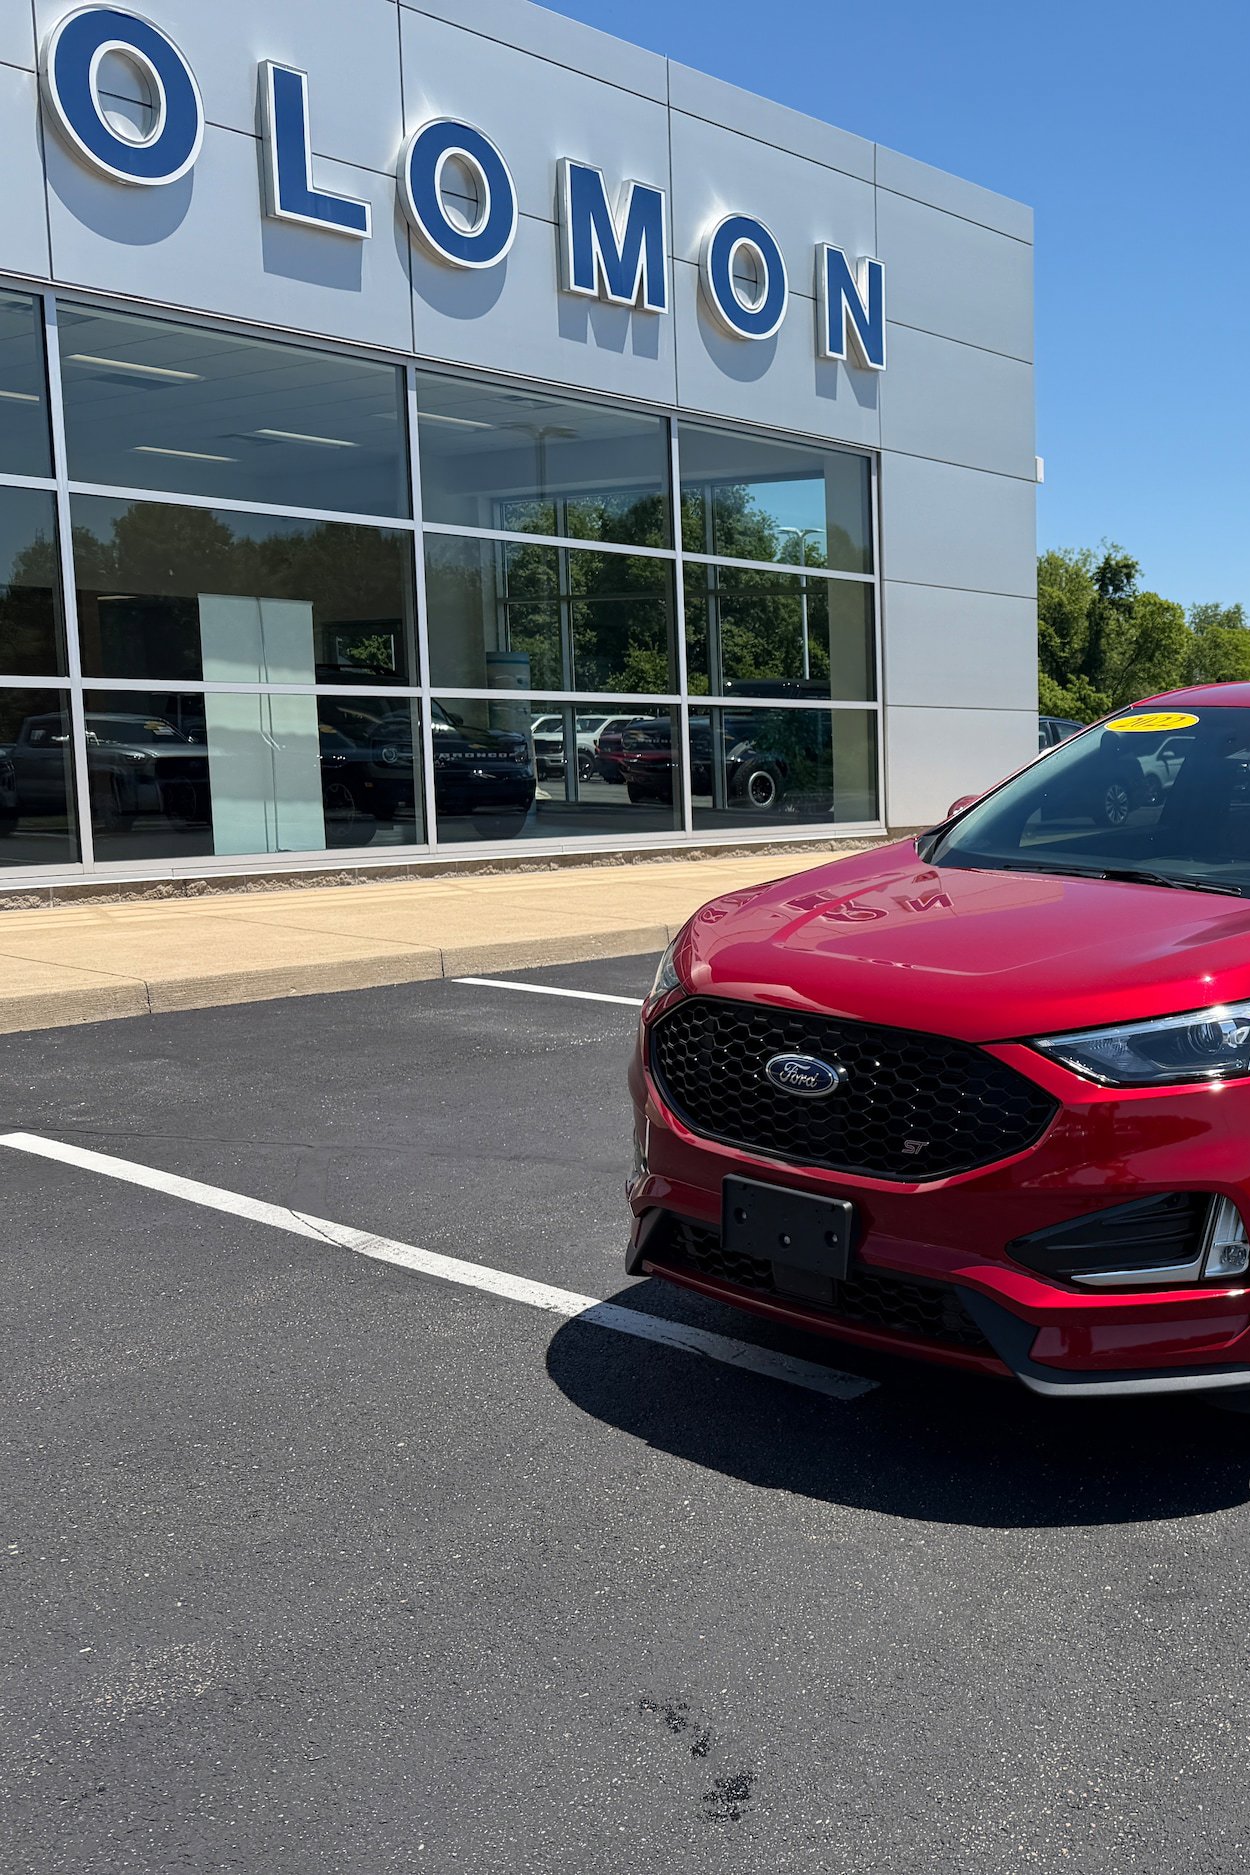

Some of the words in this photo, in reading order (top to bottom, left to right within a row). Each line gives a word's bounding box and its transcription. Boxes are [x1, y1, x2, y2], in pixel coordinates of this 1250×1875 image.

[40, 3, 886, 371] OLOMON
[1115, 716, 1187, 728] 2022
[779, 1061, 819, 1088] Ford
[901, 1139, 930, 1155] ST
